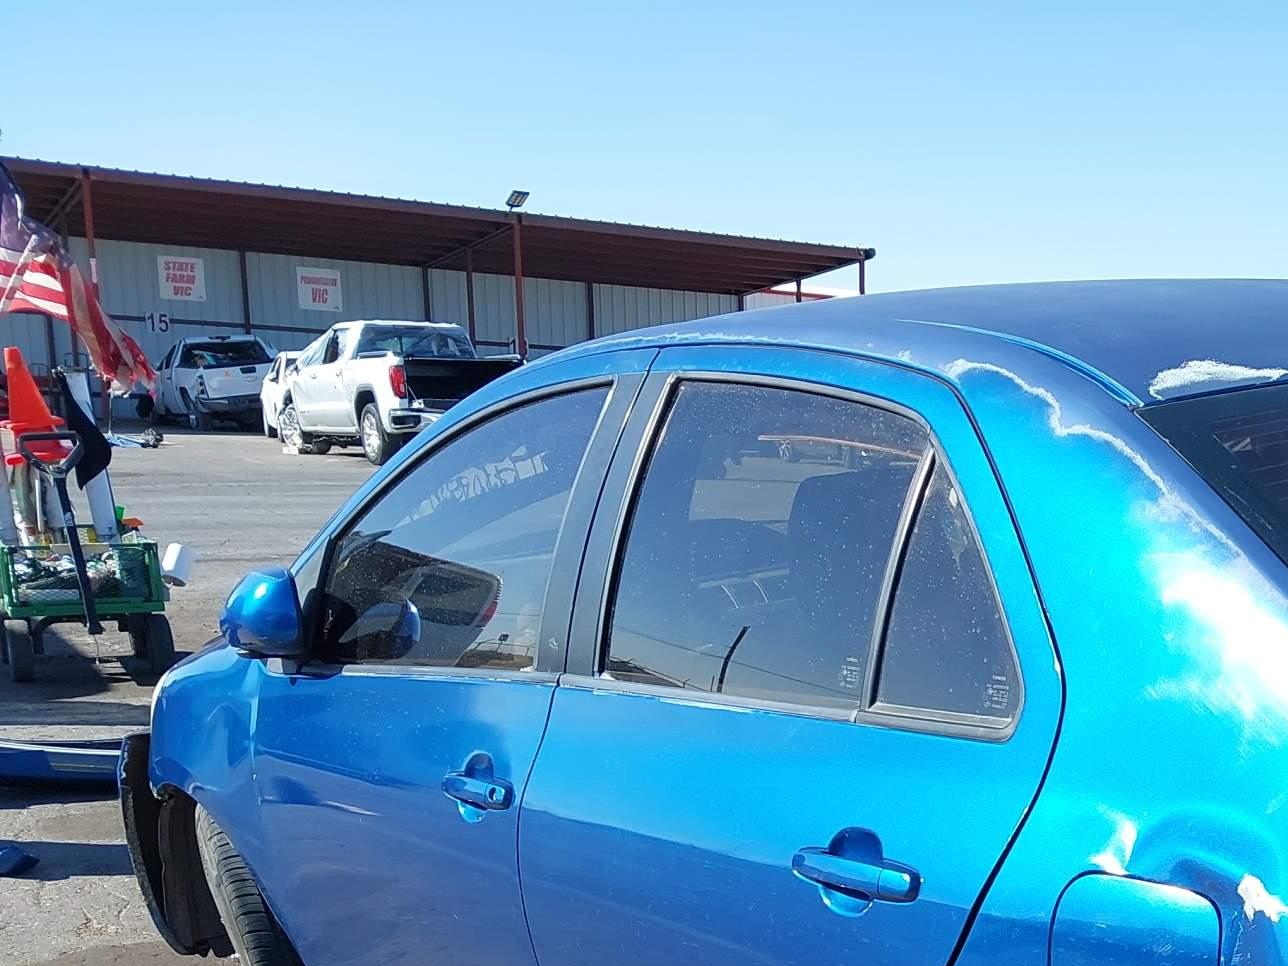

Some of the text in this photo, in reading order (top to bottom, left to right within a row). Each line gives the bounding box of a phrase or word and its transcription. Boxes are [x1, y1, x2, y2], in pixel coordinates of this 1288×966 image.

[163, 260, 197, 274] STATE
[165, 273, 196, 286] FARM
[172, 285, 192, 297] VIC
[311, 287, 328, 304] VIC
[147, 313, 169, 332] 15
